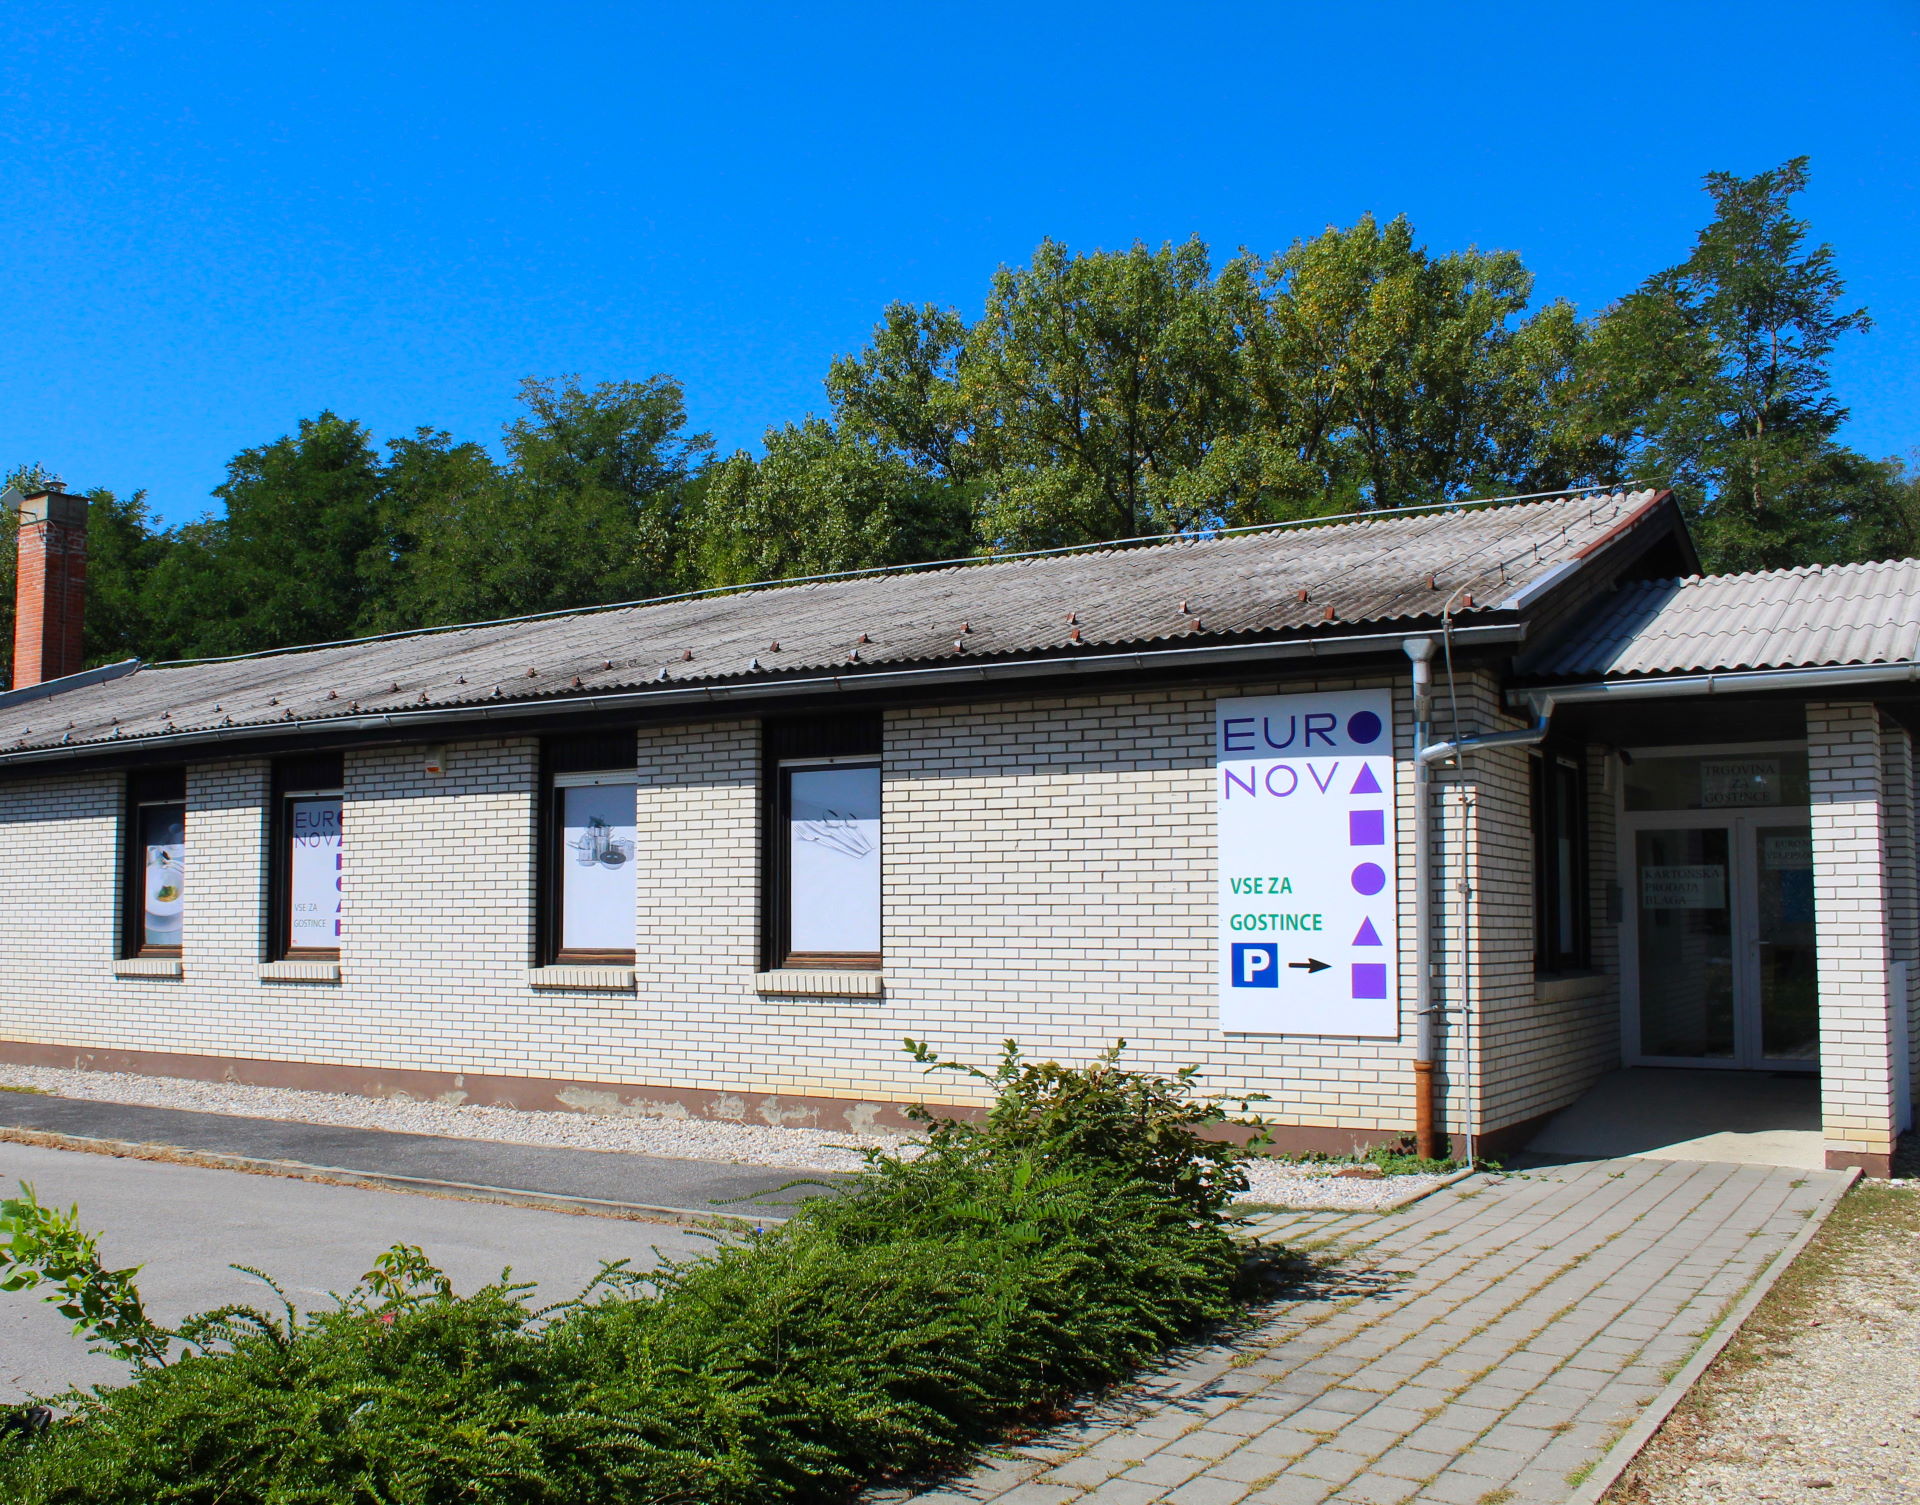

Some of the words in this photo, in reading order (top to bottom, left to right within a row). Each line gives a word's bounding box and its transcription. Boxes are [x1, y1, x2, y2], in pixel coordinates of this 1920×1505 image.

[1703, 763, 1777, 776] TRGOVINA
[1704, 791, 1770, 803] GOSTINCE
[1644, 868, 1721, 879] KARTONSKA
[1230, 877, 1263, 894] VSE
[1268, 877, 1292, 894] ZA
[295, 903, 306, 911] VSE
[307, 903, 318, 911] ZA
[293, 918, 326, 928] GOSTINCE
[1230, 913, 1323, 931] GOSTINCE
